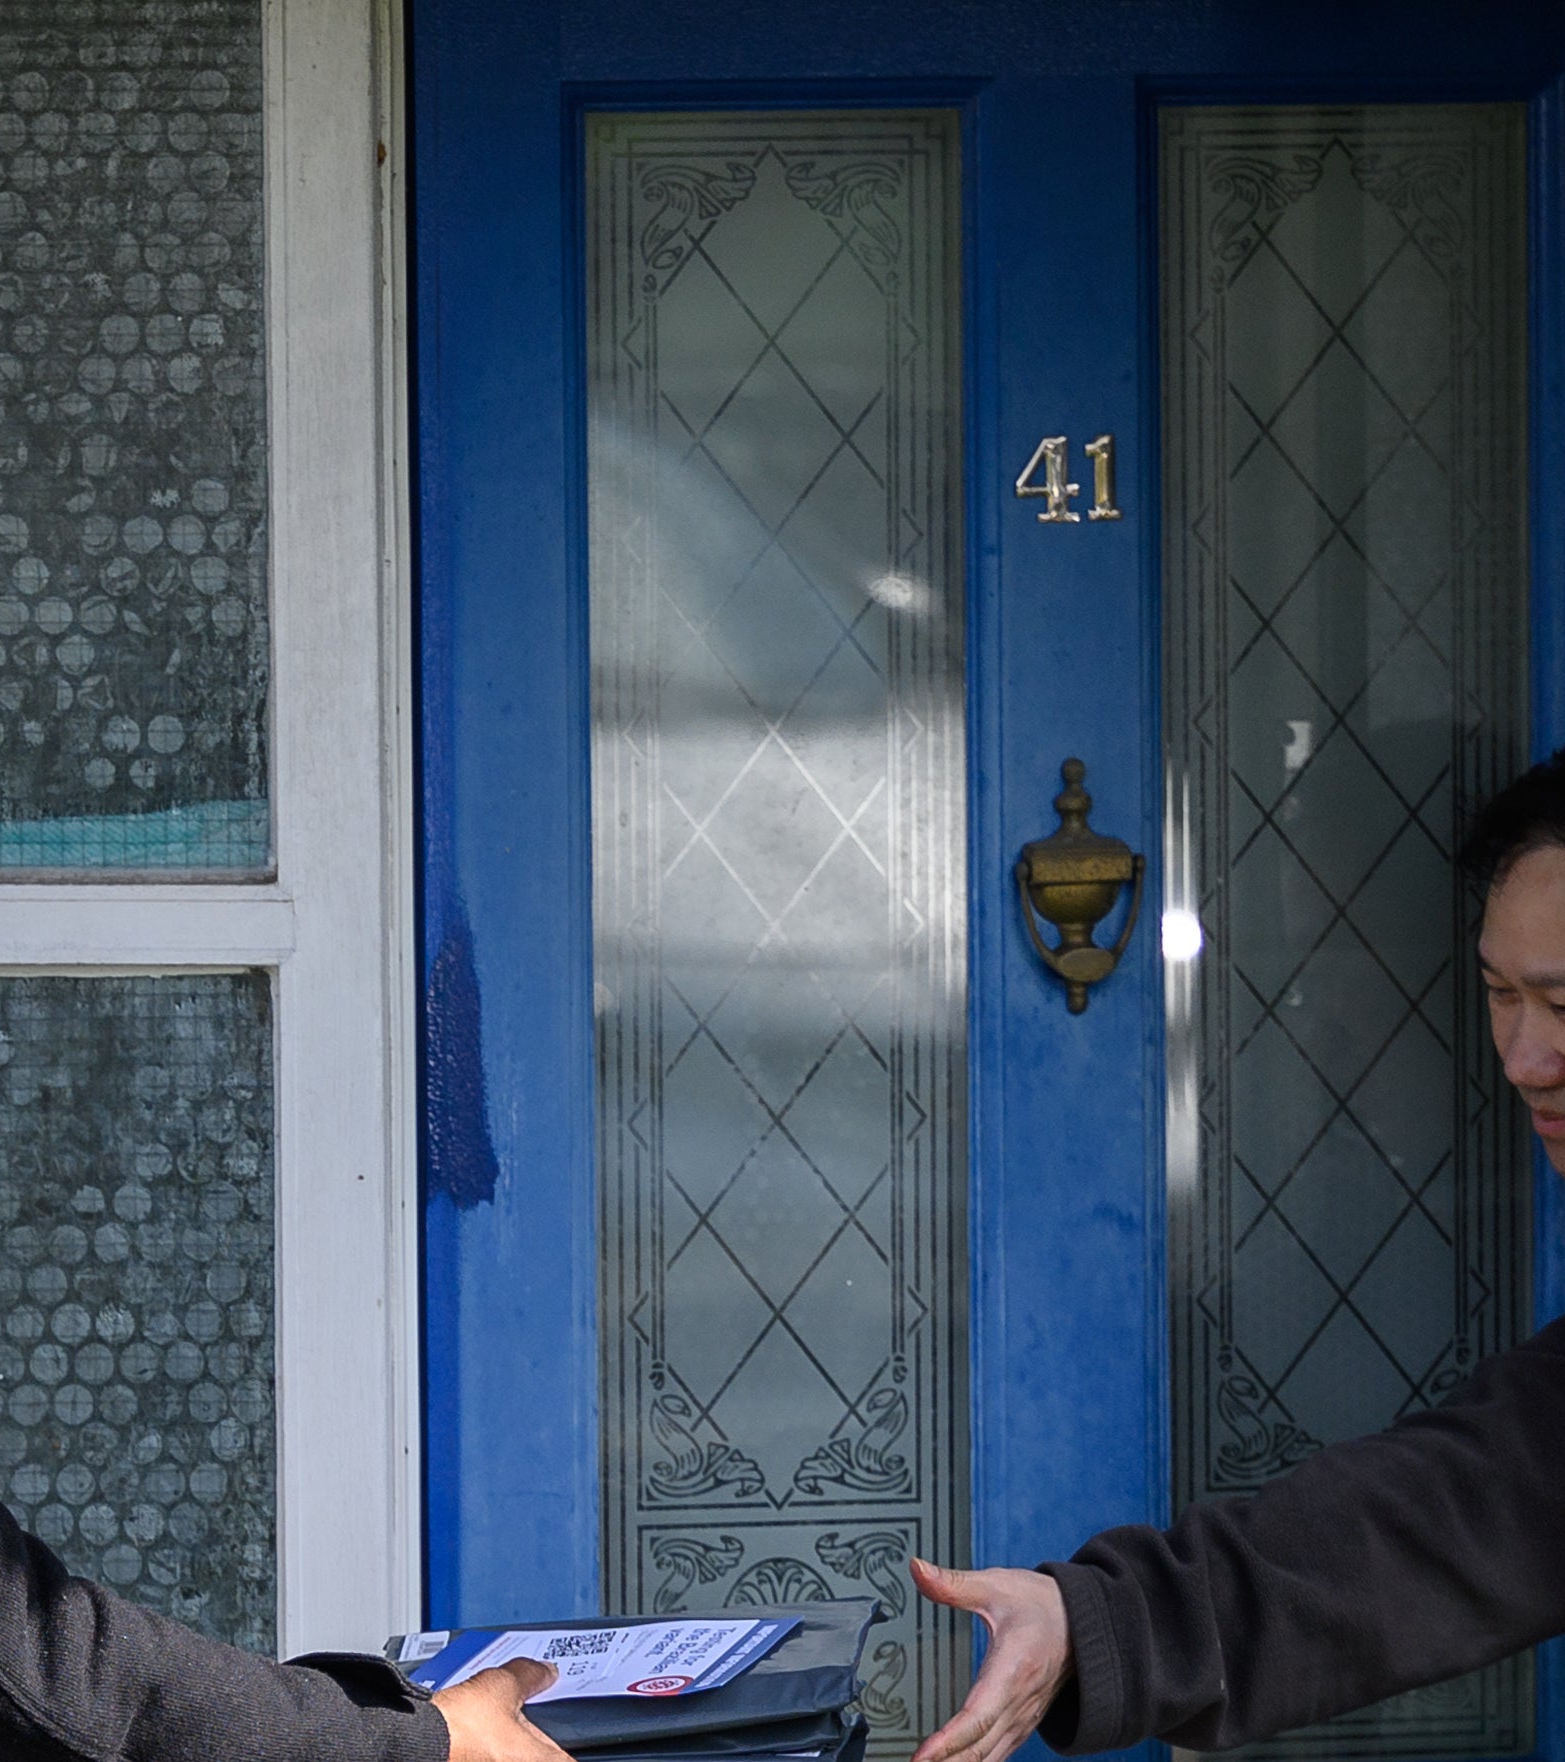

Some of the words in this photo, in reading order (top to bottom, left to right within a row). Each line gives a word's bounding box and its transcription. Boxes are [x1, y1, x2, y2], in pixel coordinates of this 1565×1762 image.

[1015, 435, 1123, 523] 41
[690, 1627, 737, 1654] Testing
[648, 1643, 698, 1674] Brazilian
